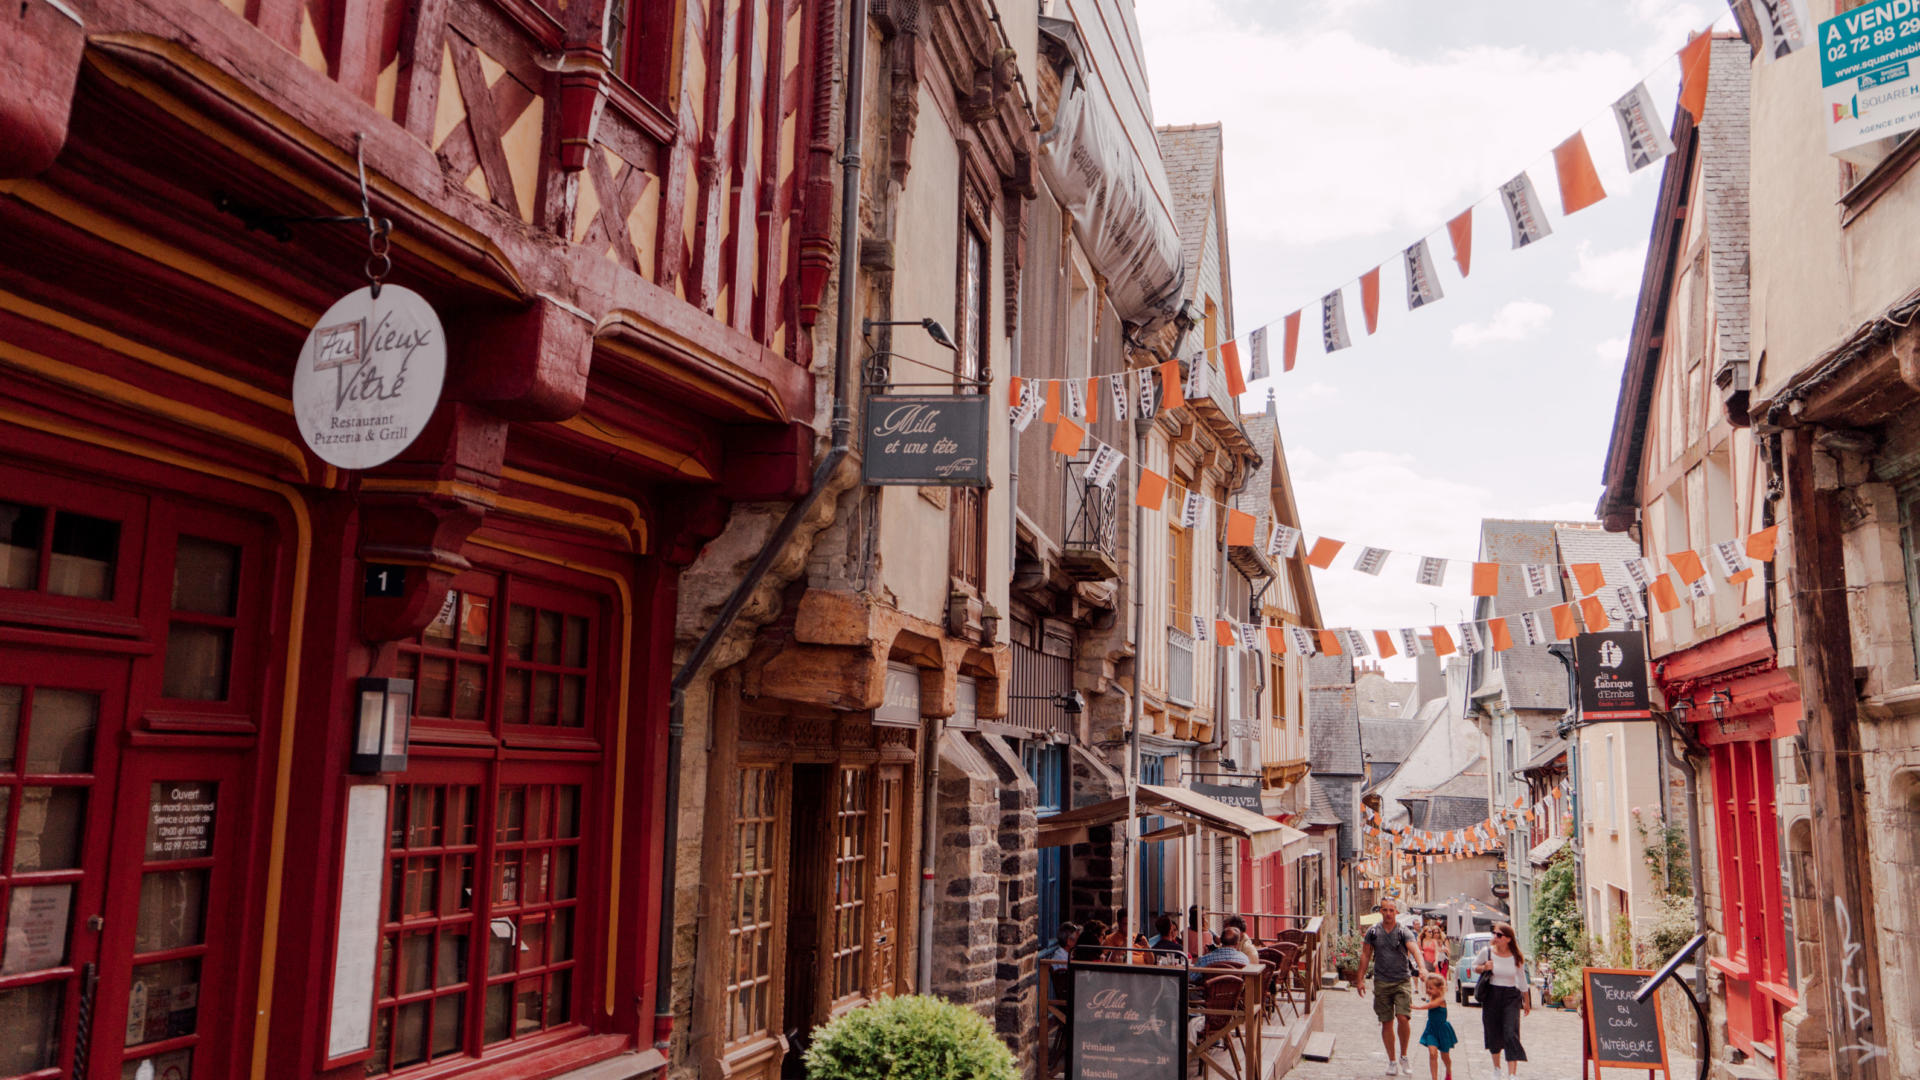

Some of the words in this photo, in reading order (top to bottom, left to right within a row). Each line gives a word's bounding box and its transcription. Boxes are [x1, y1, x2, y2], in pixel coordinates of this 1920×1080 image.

[1826, 24, 1842, 45] A
[1827, 43, 1848, 62] 02
[1850, 35, 1871, 54] 72
[1873, 26, 1896, 46] 88
[1835, 41, 1920, 78] www.squarehabi
[321, 330, 353, 361] Au
[360, 310, 432, 372] Vieux
[336, 356, 407, 412] Vitré
[330, 414, 394, 429] Restaurant
[873, 404, 941, 437] Mille
[314, 432, 361, 445] Pizzeria
[365, 429, 375, 442] &
[379, 427, 408, 441] Grill
[884, 440, 901, 454] et
[903, 442, 928, 454] une
[932, 436, 959, 454] tête
[935, 457, 978, 477] coiffure
[378, 571, 388, 591] 1
[1594, 675, 1634, 689] fabrique
[1600, 672, 1609, 680] la
[171, 788, 199, 800] Ouvert
[1209, 795, 1259, 807] RRAVEL
[154, 815, 177, 824] Service
[201, 815, 210, 823] de
[1086, 988, 1129, 1010] Mille
[1602, 985, 1637, 1001] TERRAS
[1094, 1009, 1104, 1019] et
[1104, 1010, 1122, 1019] une
[1617, 1004, 1630, 1015] EN
[1608, 1017, 1639, 1028] COUR
[1081, 1040, 1116, 1053] Féminin
[1081, 1067, 1119, 1080] Masculin
